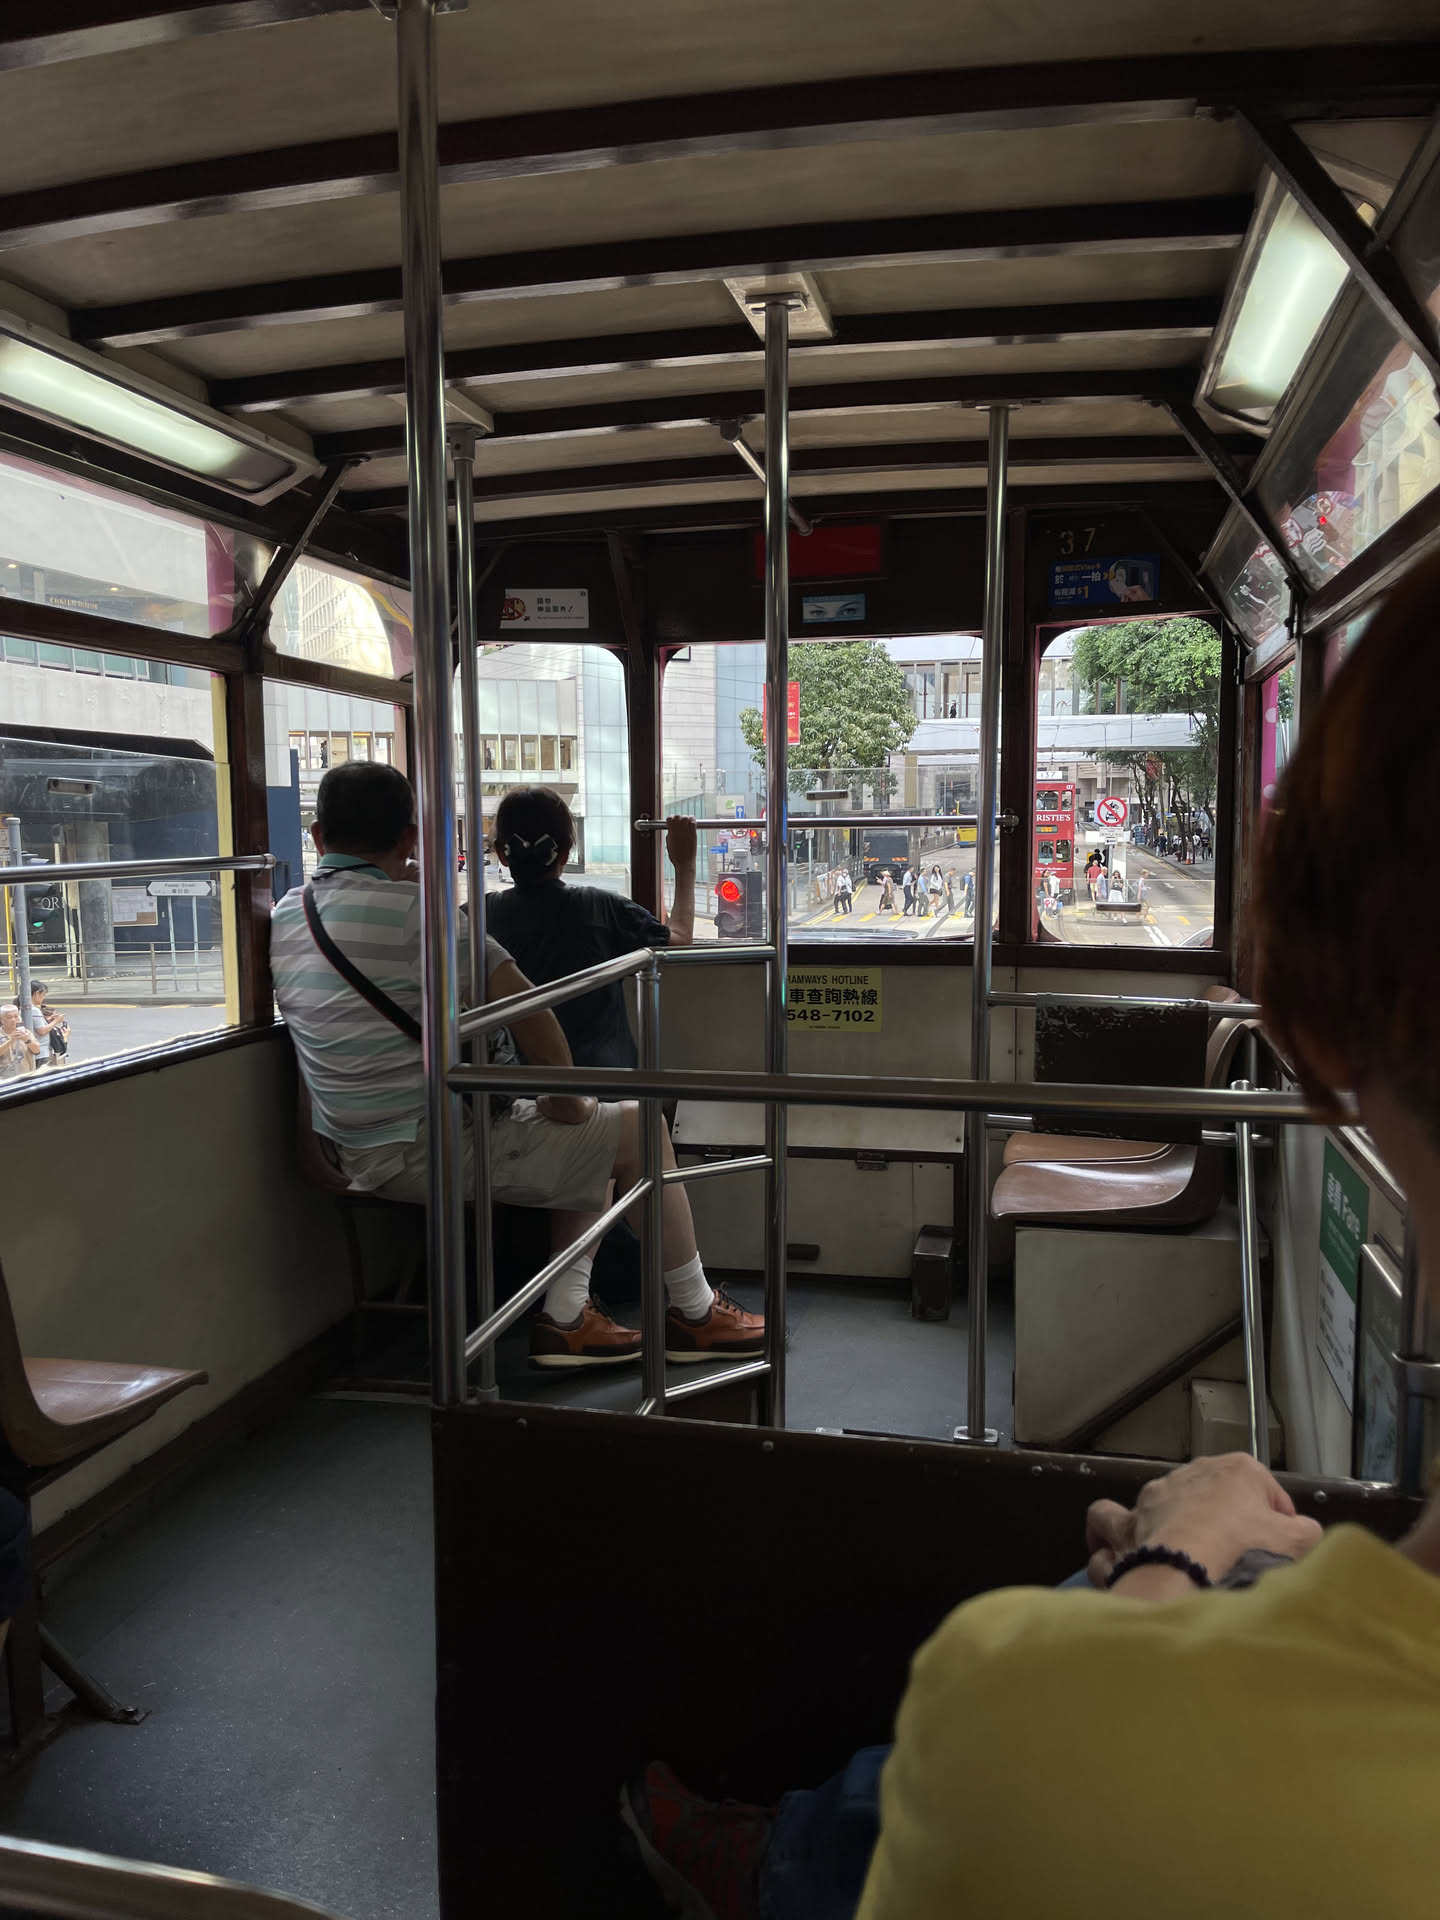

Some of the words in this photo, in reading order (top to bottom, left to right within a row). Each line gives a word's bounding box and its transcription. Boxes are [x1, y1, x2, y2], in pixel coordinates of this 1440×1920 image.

[1036, 814, 1071, 822] RISTIE'S
[832, 975, 869, 985] HOTLINE
[789, 988, 878, 1006] 車查詢熱線
[787, 1009, 875, 1022] 548-7102
